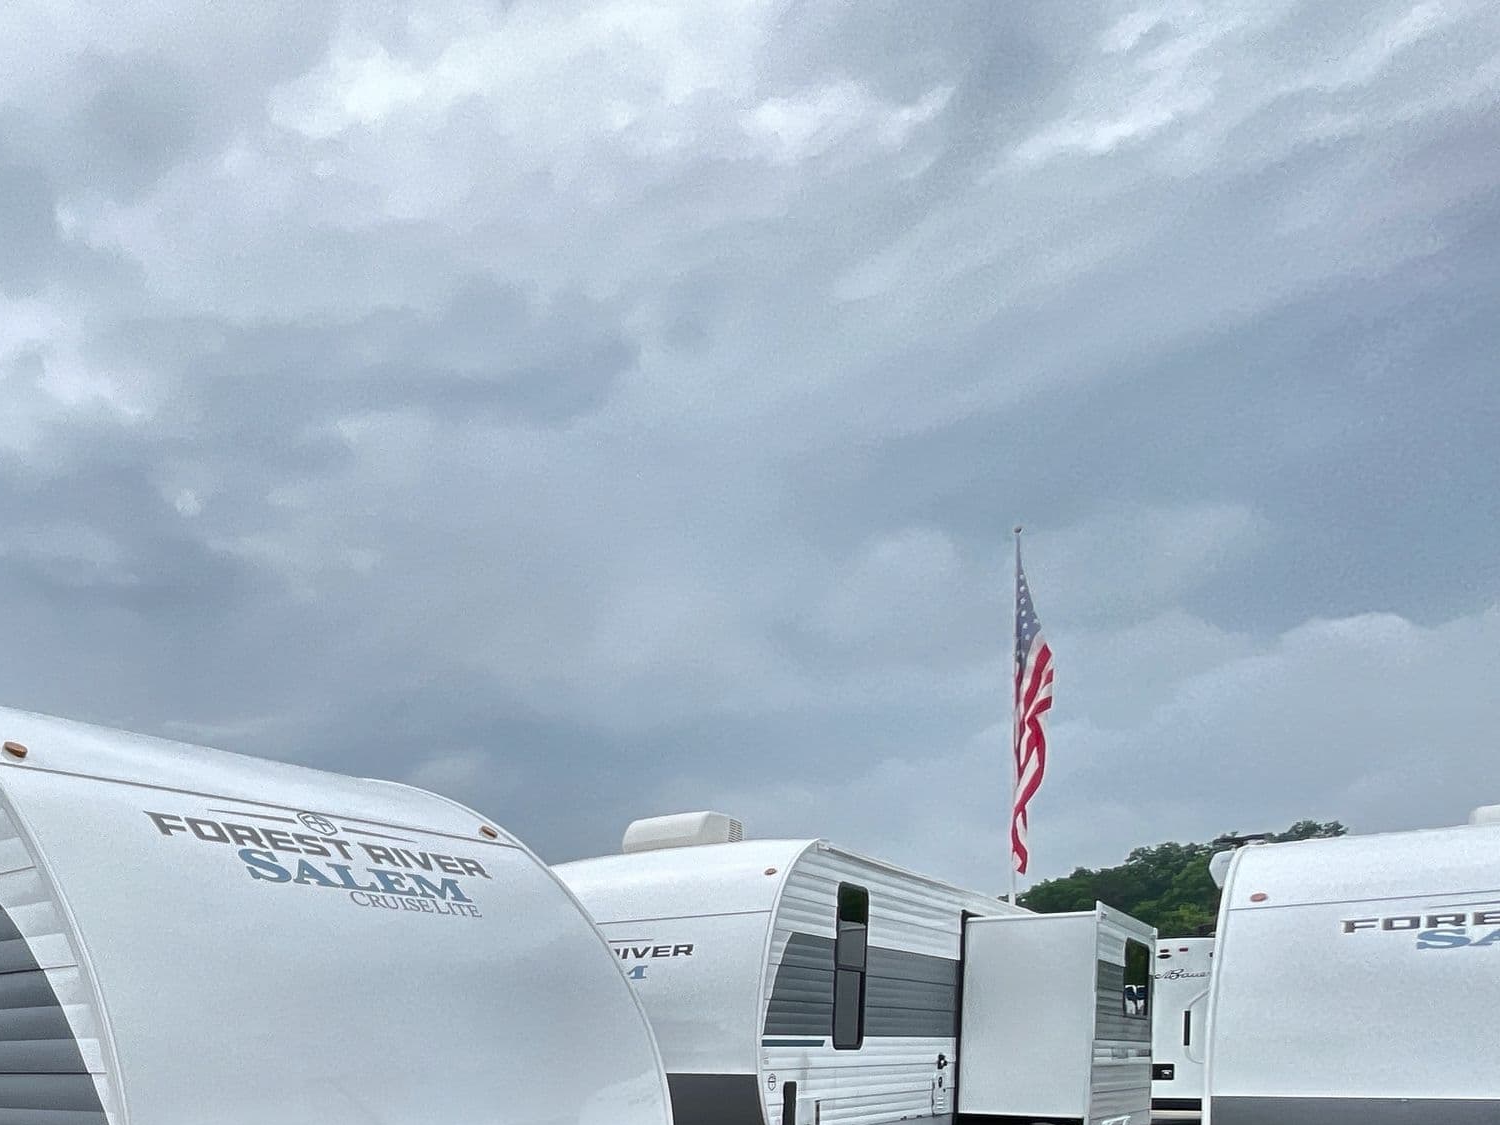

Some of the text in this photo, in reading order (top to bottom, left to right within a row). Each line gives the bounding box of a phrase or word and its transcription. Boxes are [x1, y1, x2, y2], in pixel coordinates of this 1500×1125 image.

[142, 810, 492, 879] FOREST RIVER
[237, 848, 474, 903] SALEM
